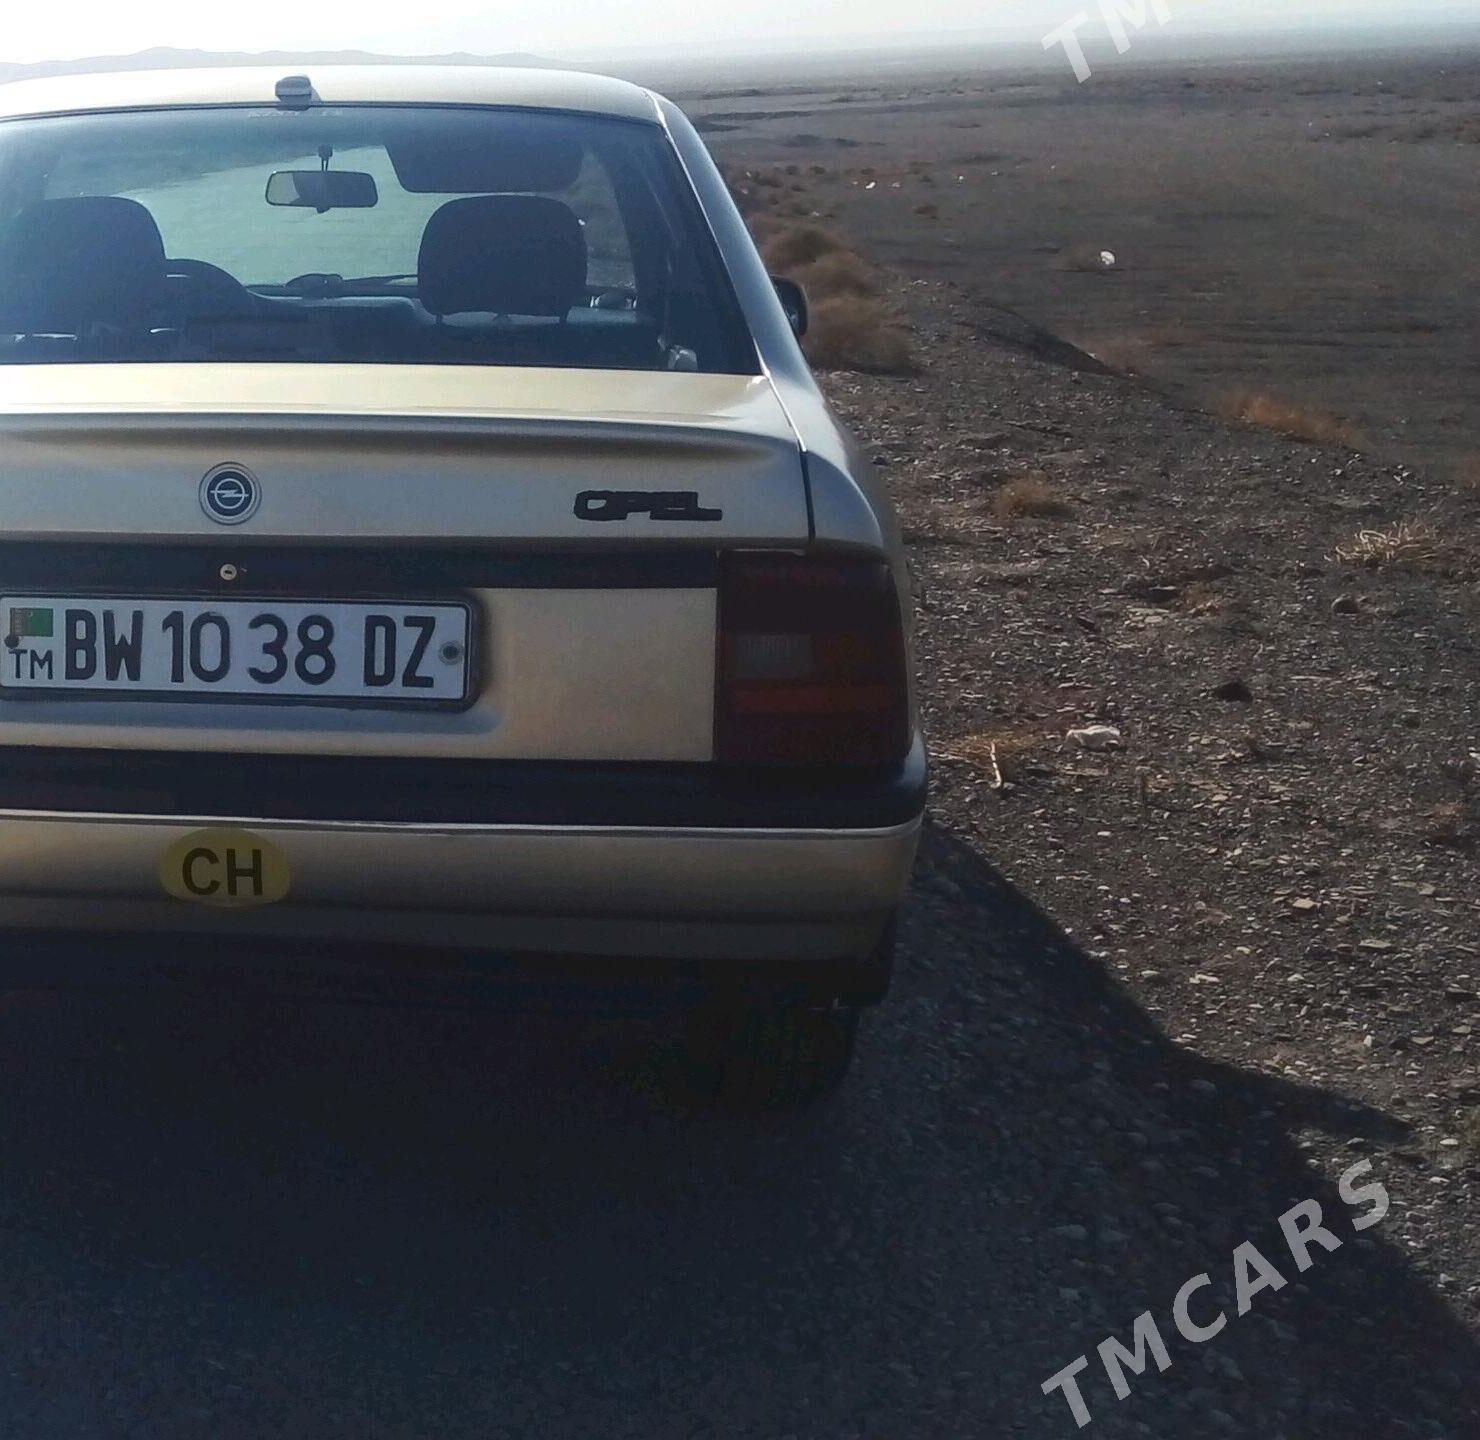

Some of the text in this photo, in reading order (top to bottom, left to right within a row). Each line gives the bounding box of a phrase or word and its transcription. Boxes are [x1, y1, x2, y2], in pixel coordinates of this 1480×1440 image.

[574, 490, 723, 521] OPEL
[9, 648, 54, 681] TM
[64, 608, 437, 688] BW 10 38 DZ
[181, 847, 264, 897] CH
